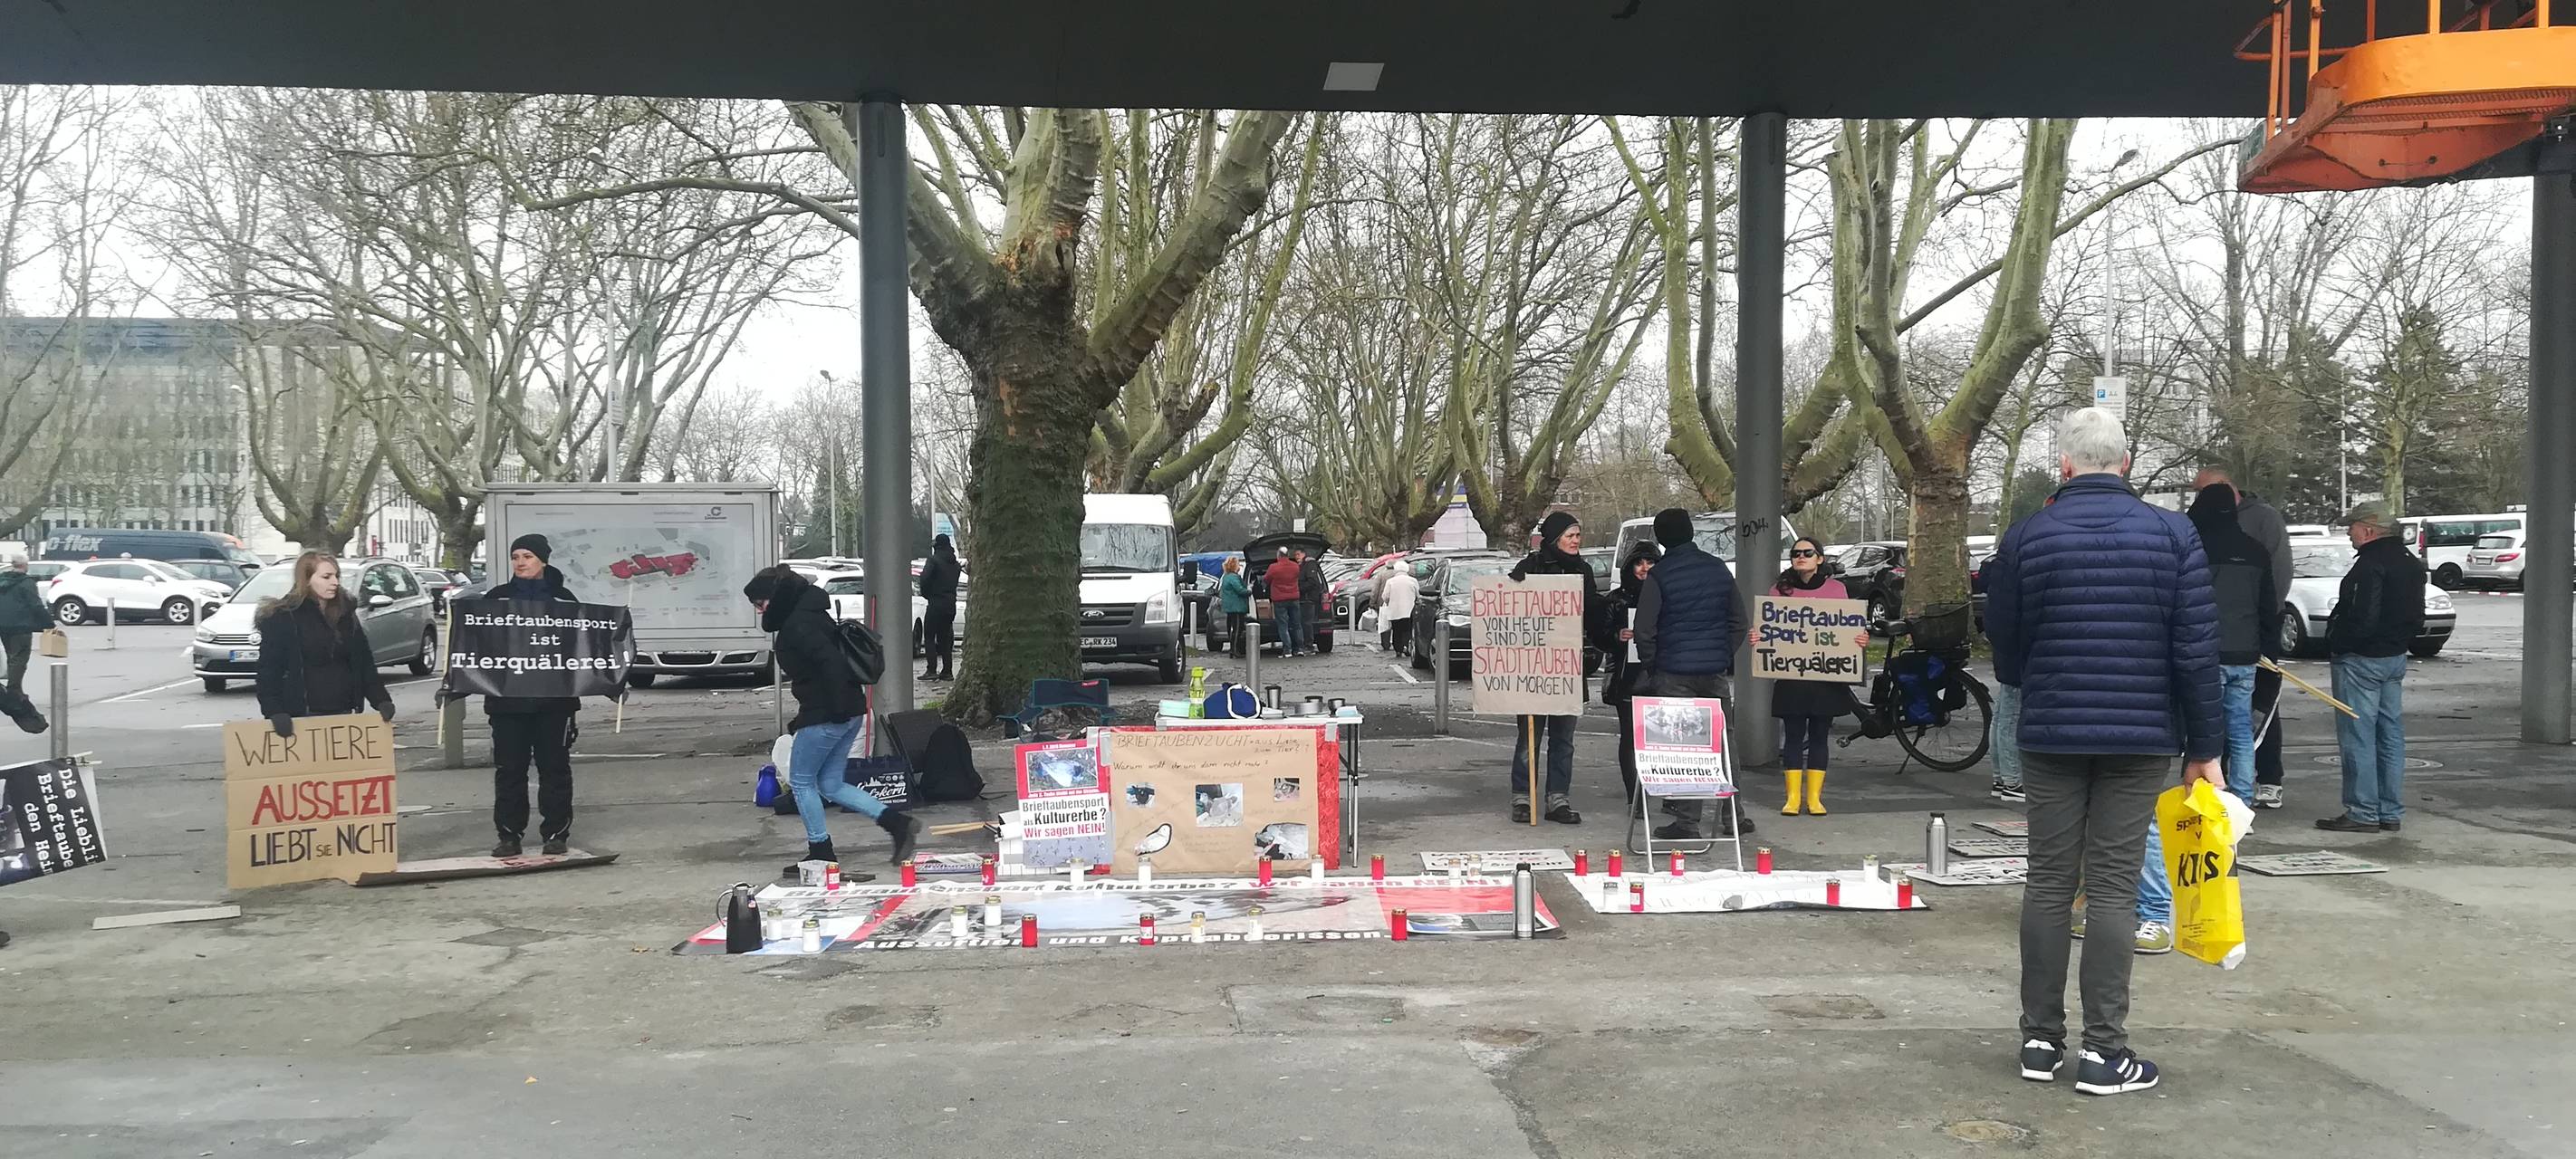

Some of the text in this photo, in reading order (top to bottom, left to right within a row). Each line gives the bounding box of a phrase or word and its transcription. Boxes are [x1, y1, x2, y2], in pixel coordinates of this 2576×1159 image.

[465, 614, 618, 631] Brieftaubensport
[1483, 617, 1556, 632] VON HEUTE
[530, 633, 561, 646] ist
[1485, 632, 1546, 647] SIND DIE
[1815, 627, 1841, 647] ist
[451, 650, 631, 675] Tierquälerei!
[1473, 647, 1583, 675] STADTTAUBEN
[1756, 648, 1858, 677] Tierquälerei
[1483, 675, 1574, 695] VON MORGEN
[235, 725, 382, 767] WER TIERE
[1639, 752, 1717, 766] Brieftaubensport
[252, 775, 396, 826] AUSSETZT
[1023, 797, 1105, 812] Brieftaubensport
[24, 802, 42, 832] den
[70, 806, 99, 865] Liebli
[1024, 822, 1106, 838] Wir sagen NEIN!
[251, 828, 317, 867] LIEBT
[337, 822, 396, 856] NICHT
[853, 938, 1023, 949] Aussortier
[1048, 935, 1108, 944] und
